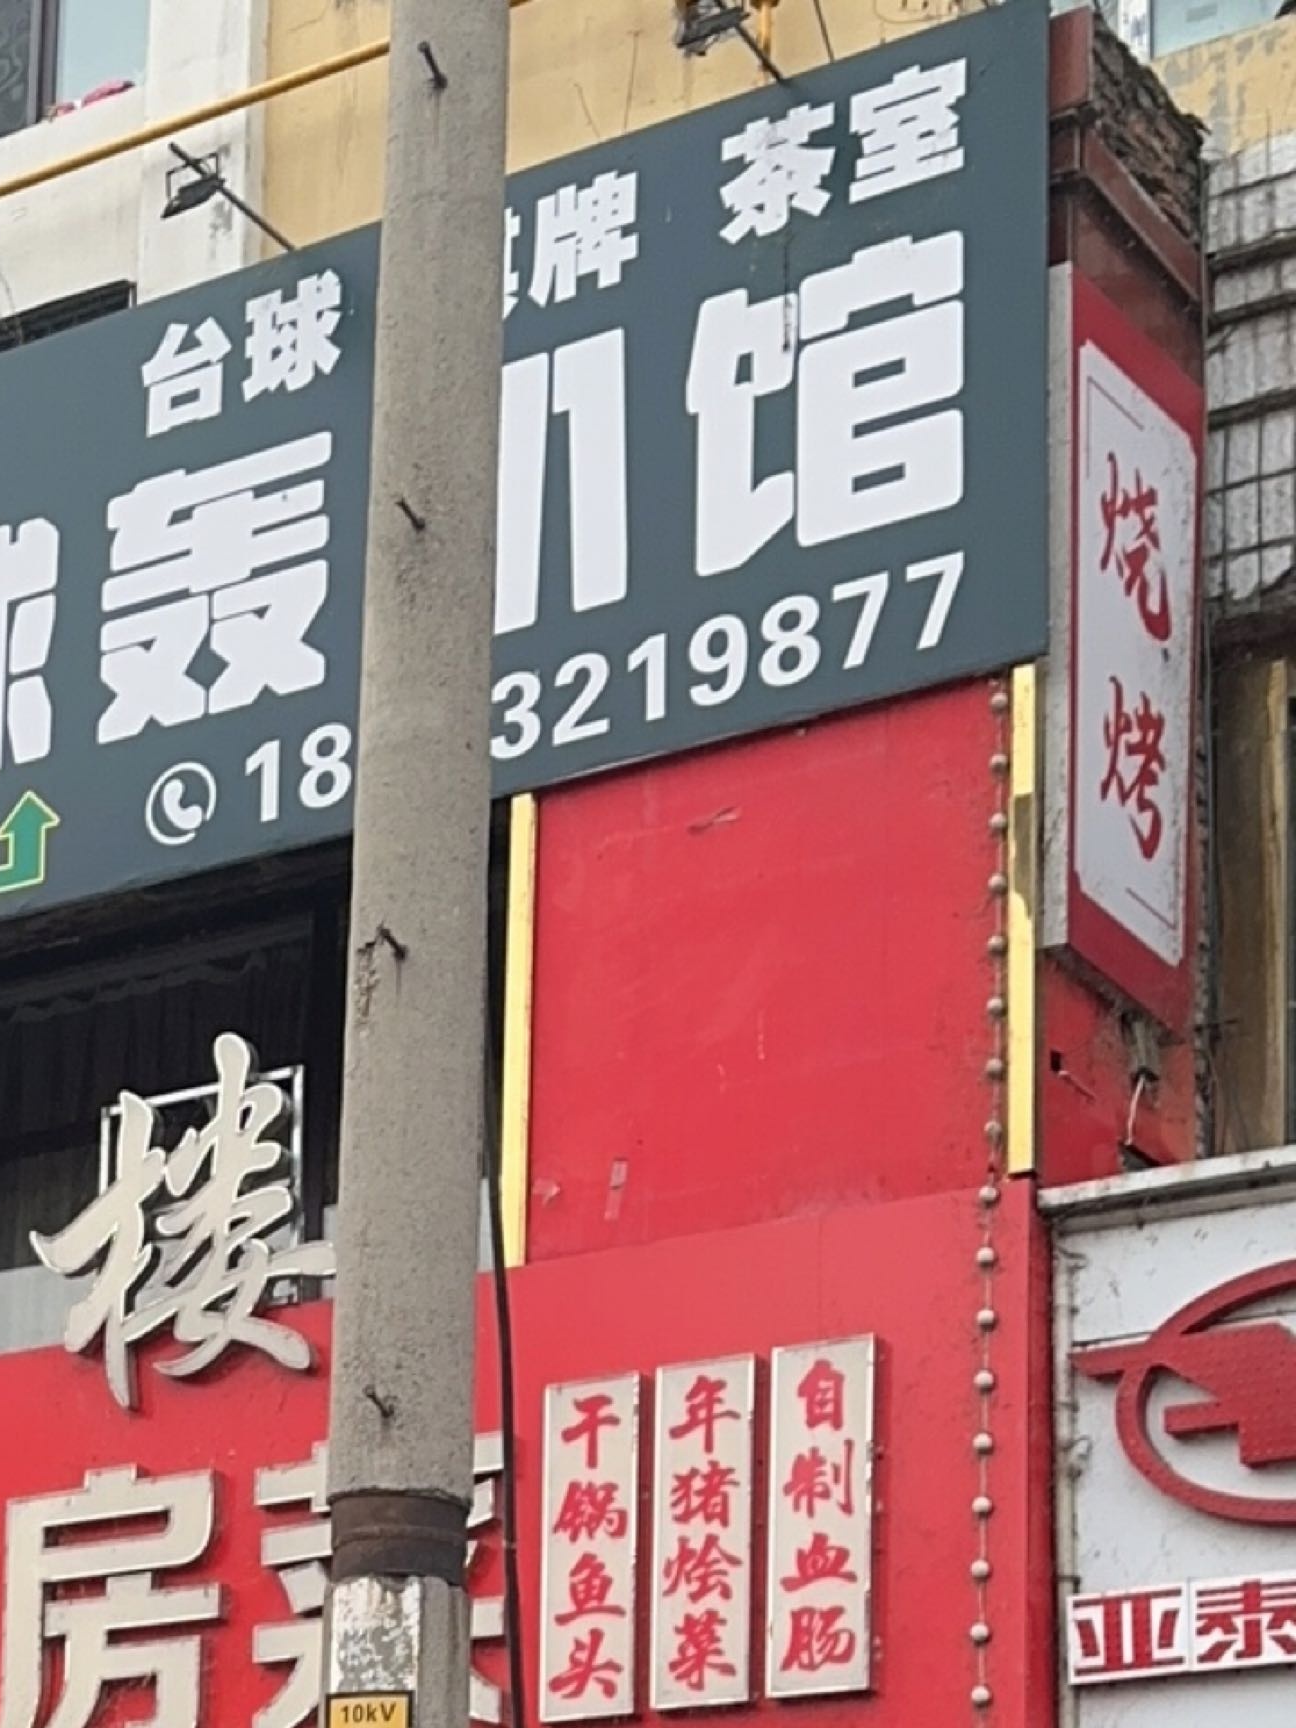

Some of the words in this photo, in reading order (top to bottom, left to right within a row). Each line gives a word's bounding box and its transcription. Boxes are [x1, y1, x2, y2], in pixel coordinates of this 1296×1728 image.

[141, 268, 343, 438] 台球
[500, 170, 639, 320] 牌
[720, 57, 968, 244] 茶室
[244, 552, 967, 823] 183219877
[1100, 450, 1172, 861] 烧烤
[548, 1394, 628, 1700] 干锅鱼头
[663, 1374, 743, 1691] 年猪烩菜
[780, 1358, 857, 1673] 自制血肠
[1070, 1578, 1296, 1676] 亚泰
[340, 1702, 396, 1723] 10kV
